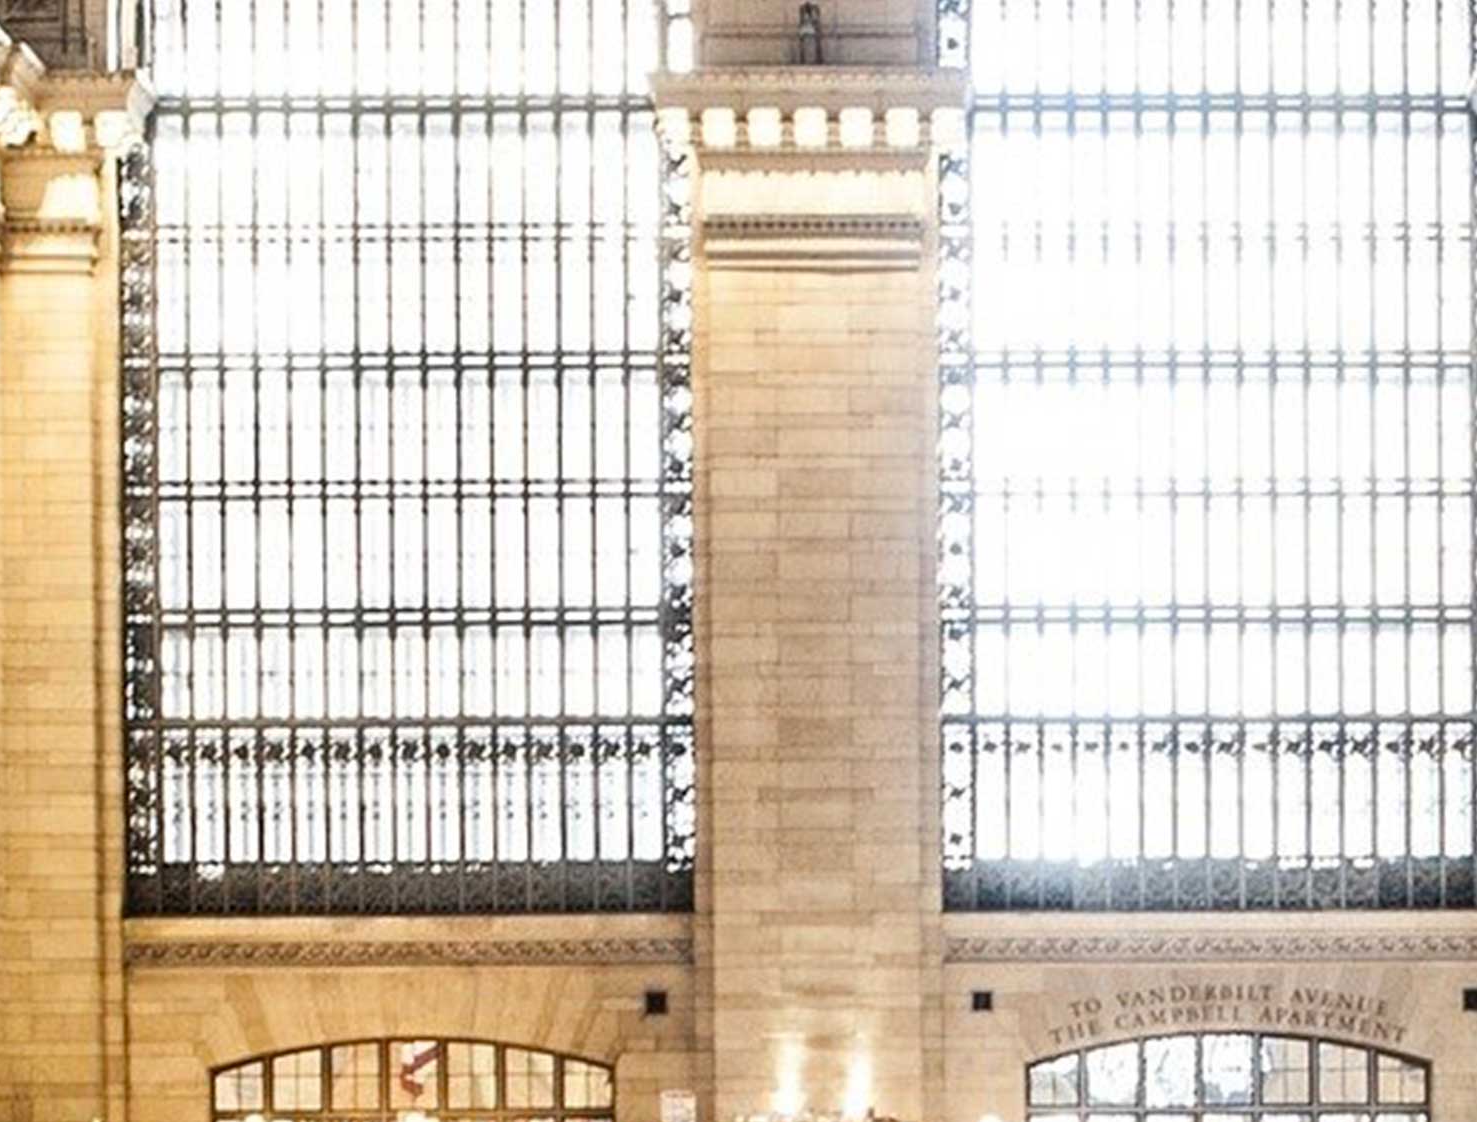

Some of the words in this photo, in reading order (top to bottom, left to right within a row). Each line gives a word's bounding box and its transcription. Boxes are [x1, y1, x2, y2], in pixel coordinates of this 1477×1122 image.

[1068, 997, 1102, 1018] TO
[1115, 984, 1273, 1007] VANDERBILT
[1289, 987, 1389, 1016] AVENUE
[1047, 1019, 1101, 1045] THE
[1114, 1004, 1241, 1030] CAMPBELL
[1258, 1005, 1407, 1042] APARTMENT
